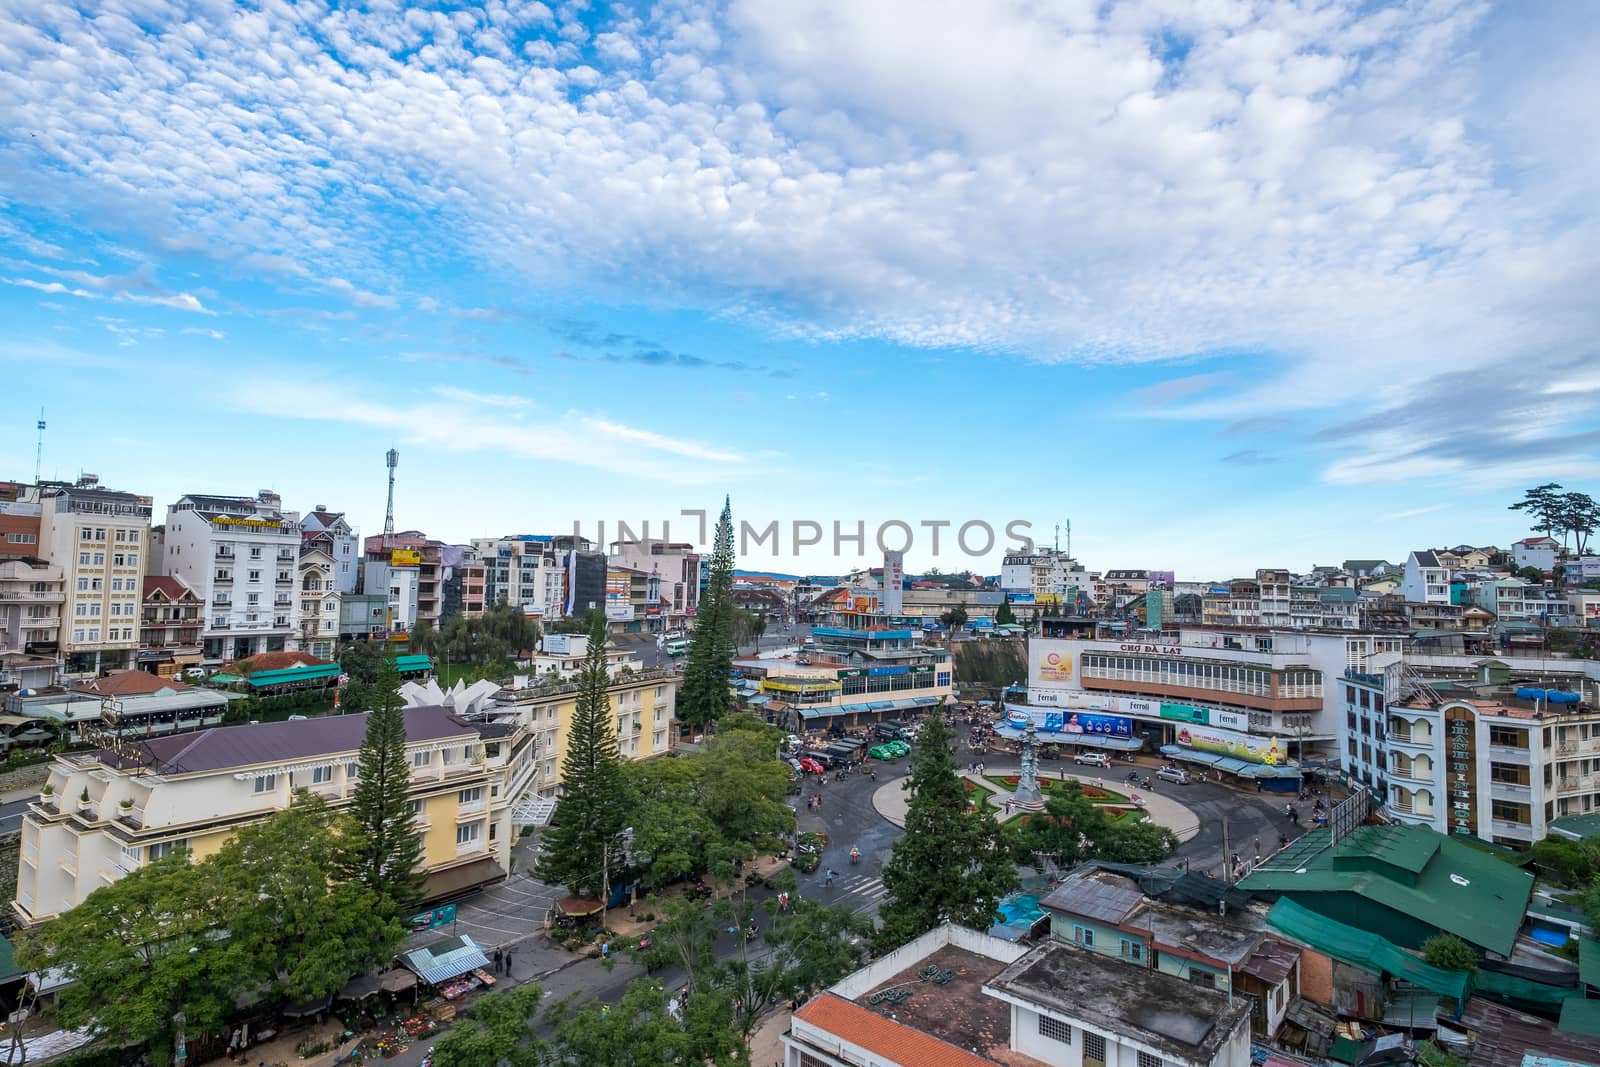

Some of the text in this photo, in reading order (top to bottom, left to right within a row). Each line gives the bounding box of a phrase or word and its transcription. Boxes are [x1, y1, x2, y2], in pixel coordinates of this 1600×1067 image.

[1120, 644, 1182, 656] CHỢ ĐÀ LẠT
[1038, 693, 1058, 702] Ferroli
[1130, 702, 1150, 710] Ferroli
[1219, 713, 1238, 724] Ferroli
[1453, 801, 1471, 835] HOTE
